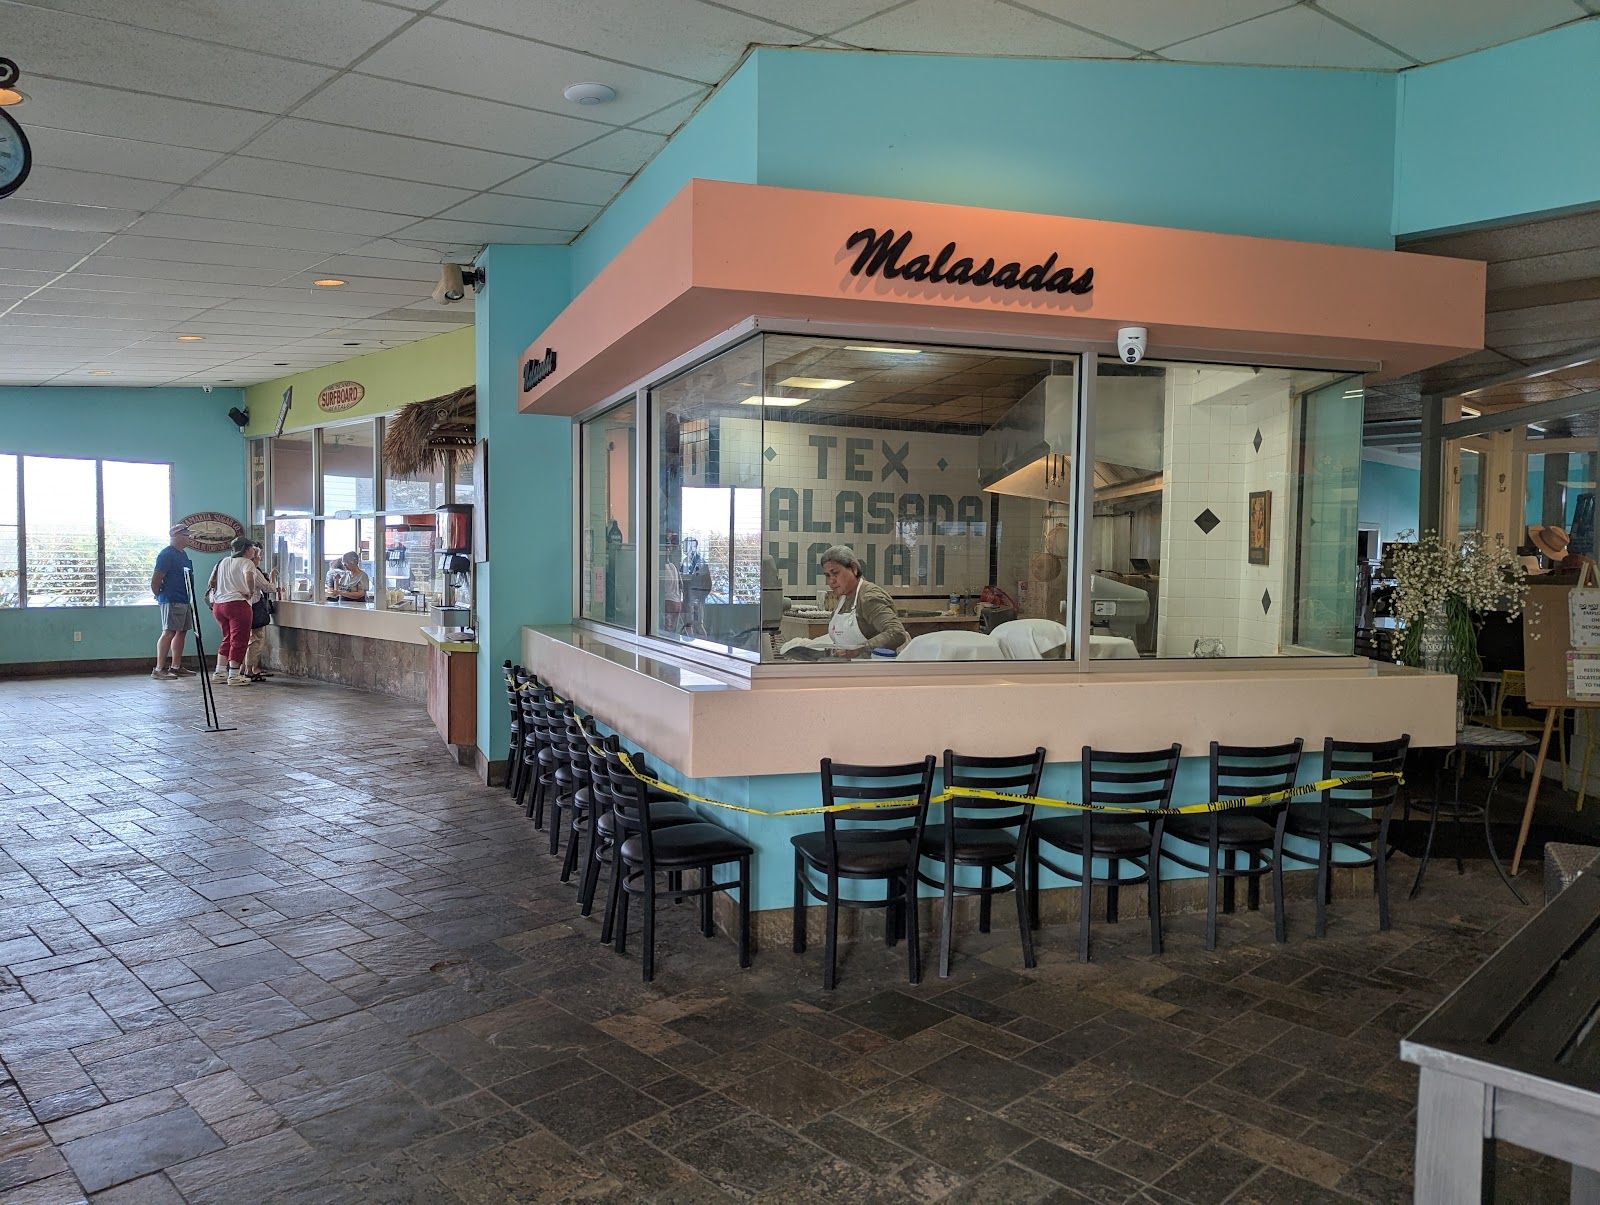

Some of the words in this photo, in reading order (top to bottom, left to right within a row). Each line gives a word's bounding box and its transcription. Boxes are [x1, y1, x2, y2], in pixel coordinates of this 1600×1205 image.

[847, 228, 1094, 295] Malasadas
[321, 386, 358, 407] SURFBOARD
[808, 434, 910, 484] TEX
[182, 513, 212, 527] AMAKUA
[767, 486, 984, 536] ALASADA
